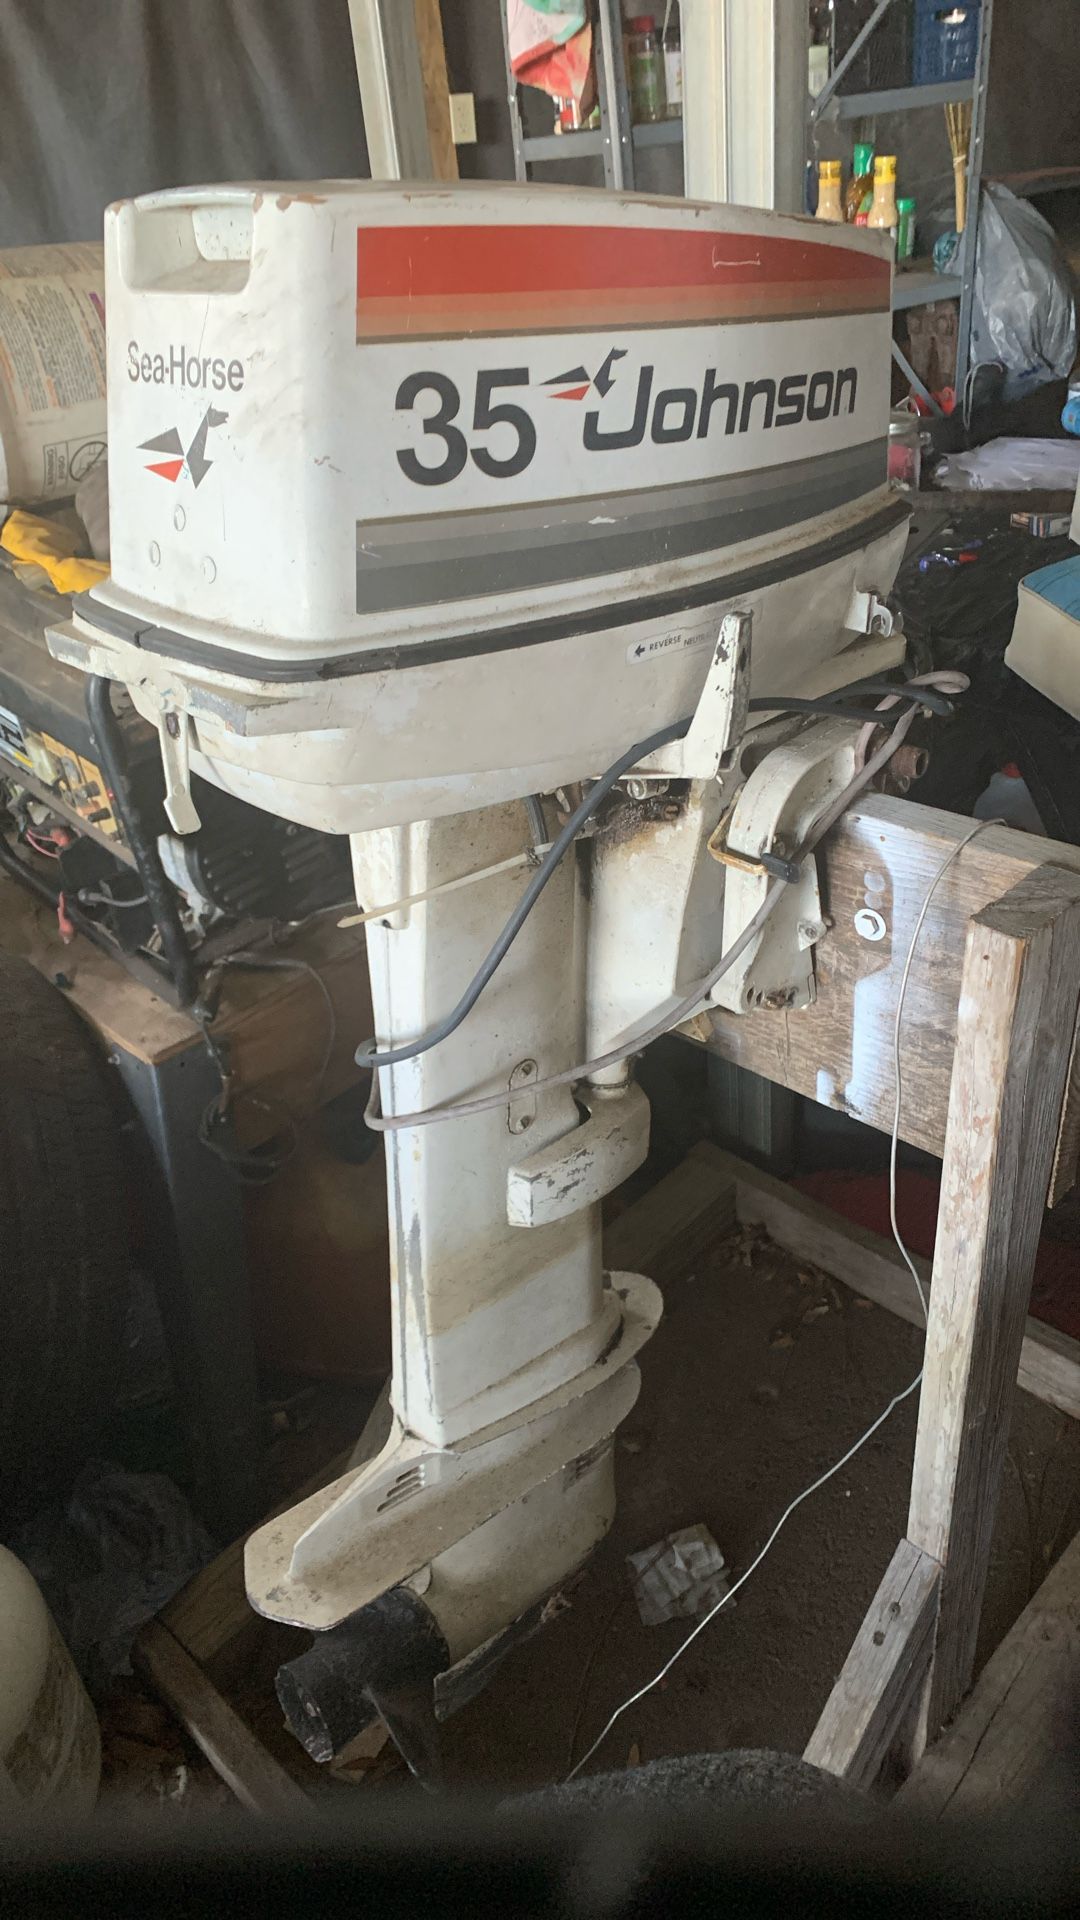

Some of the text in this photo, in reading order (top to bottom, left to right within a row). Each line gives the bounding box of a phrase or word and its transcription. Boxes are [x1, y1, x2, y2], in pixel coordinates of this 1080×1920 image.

[127, 340, 244, 392] Sea-Horse
[395, 365, 857, 486] 35 Johnson
[649, 635, 682, 652] REVERSE
